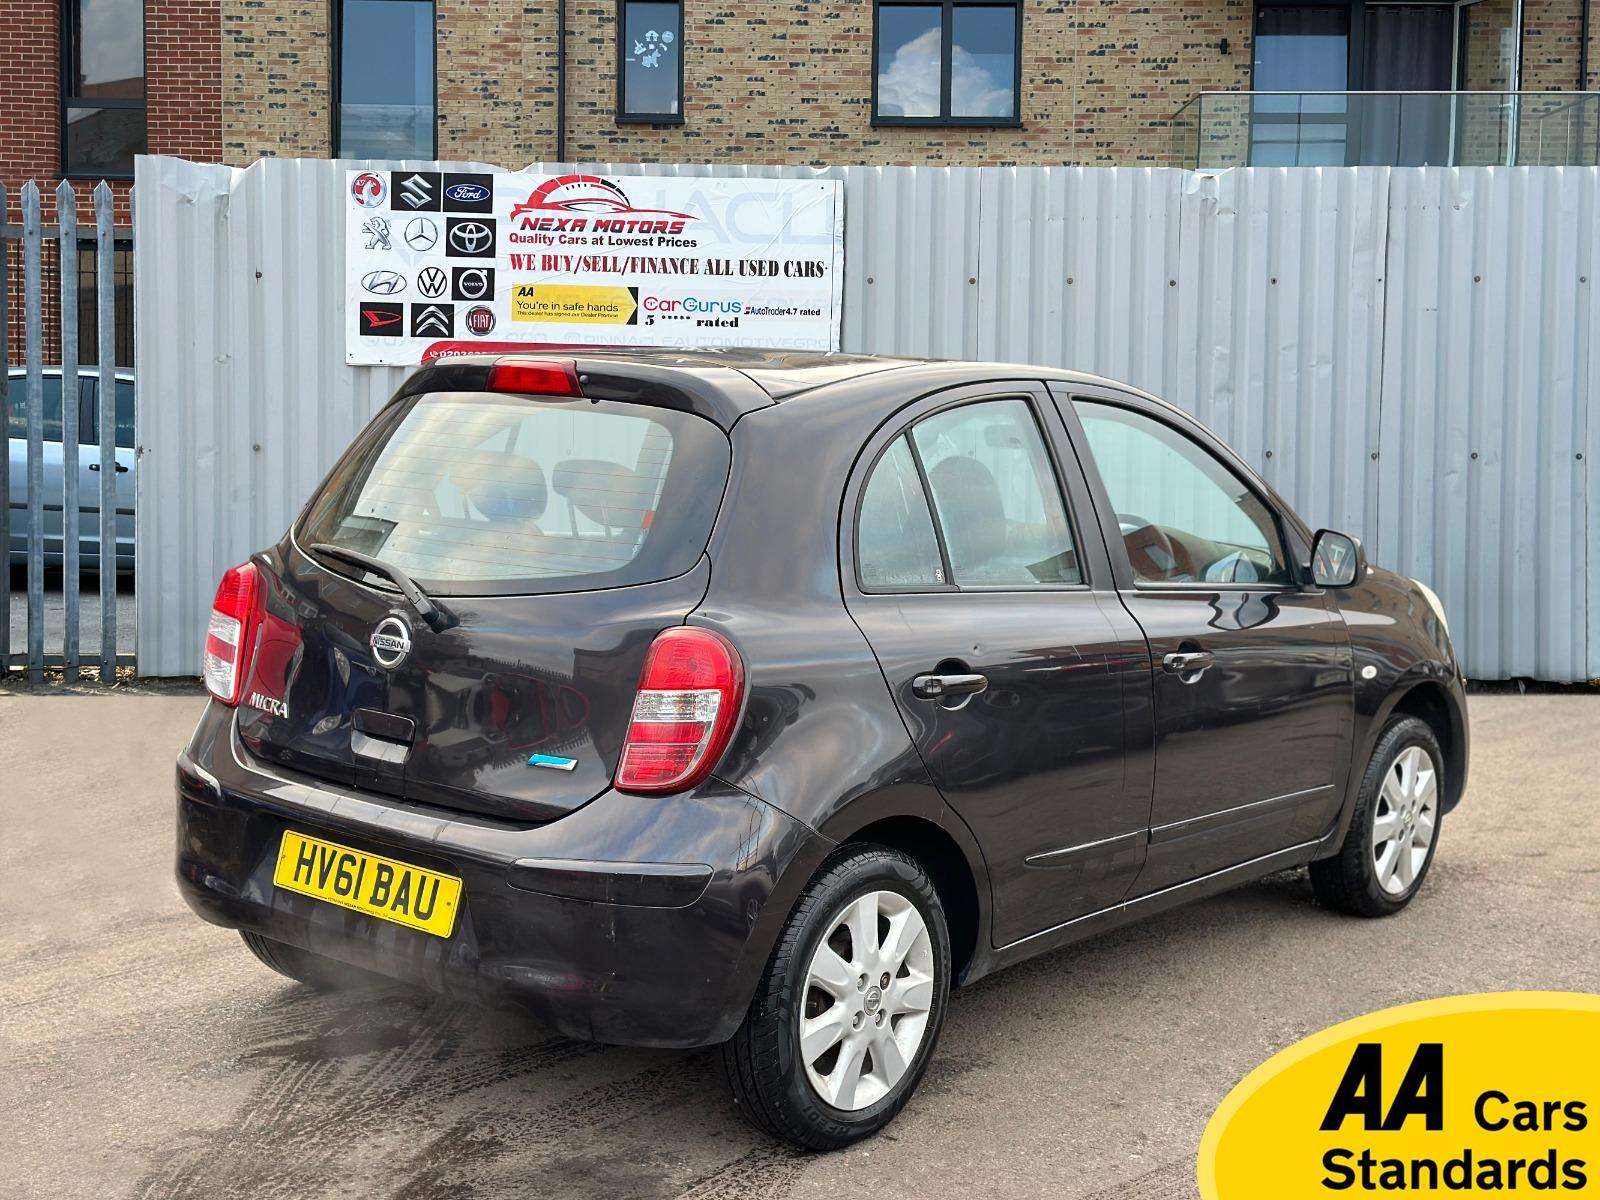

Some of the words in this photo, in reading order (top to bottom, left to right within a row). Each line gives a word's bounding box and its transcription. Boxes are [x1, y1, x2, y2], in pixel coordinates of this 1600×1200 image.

[454, 187, 481, 198] Ford
[520, 217, 587, 231] NEXA
[592, 219, 685, 234] MOTORS
[509, 233, 554, 246] Quality
[559, 235, 587, 245] Cars
[591, 236, 604, 246] at
[608, 236, 653, 246] Lowest
[657, 238, 697, 248] Prices
[510, 254, 535, 271] WE
[704, 259, 733, 275] ALL
[739, 260, 779, 277] USED
[784, 260, 824, 278] CARS
[518, 286, 534, 297] AA
[516, 300, 549, 310] You're
[551, 301, 560, 310] in
[563, 303, 585, 311] safe
[587, 303, 619, 312] hands
[643, 296, 742, 313] CarGurus
[800, 308, 821, 316] rated
[473, 314, 489, 328] FIAT
[645, 315, 655, 326] 5
[697, 317, 739, 327] rated
[372, 636, 405, 650] NISSAN
[250, 691, 288, 719] MICRA
[293, 841, 366, 900] HV61
[369, 860, 440, 921] BAU
